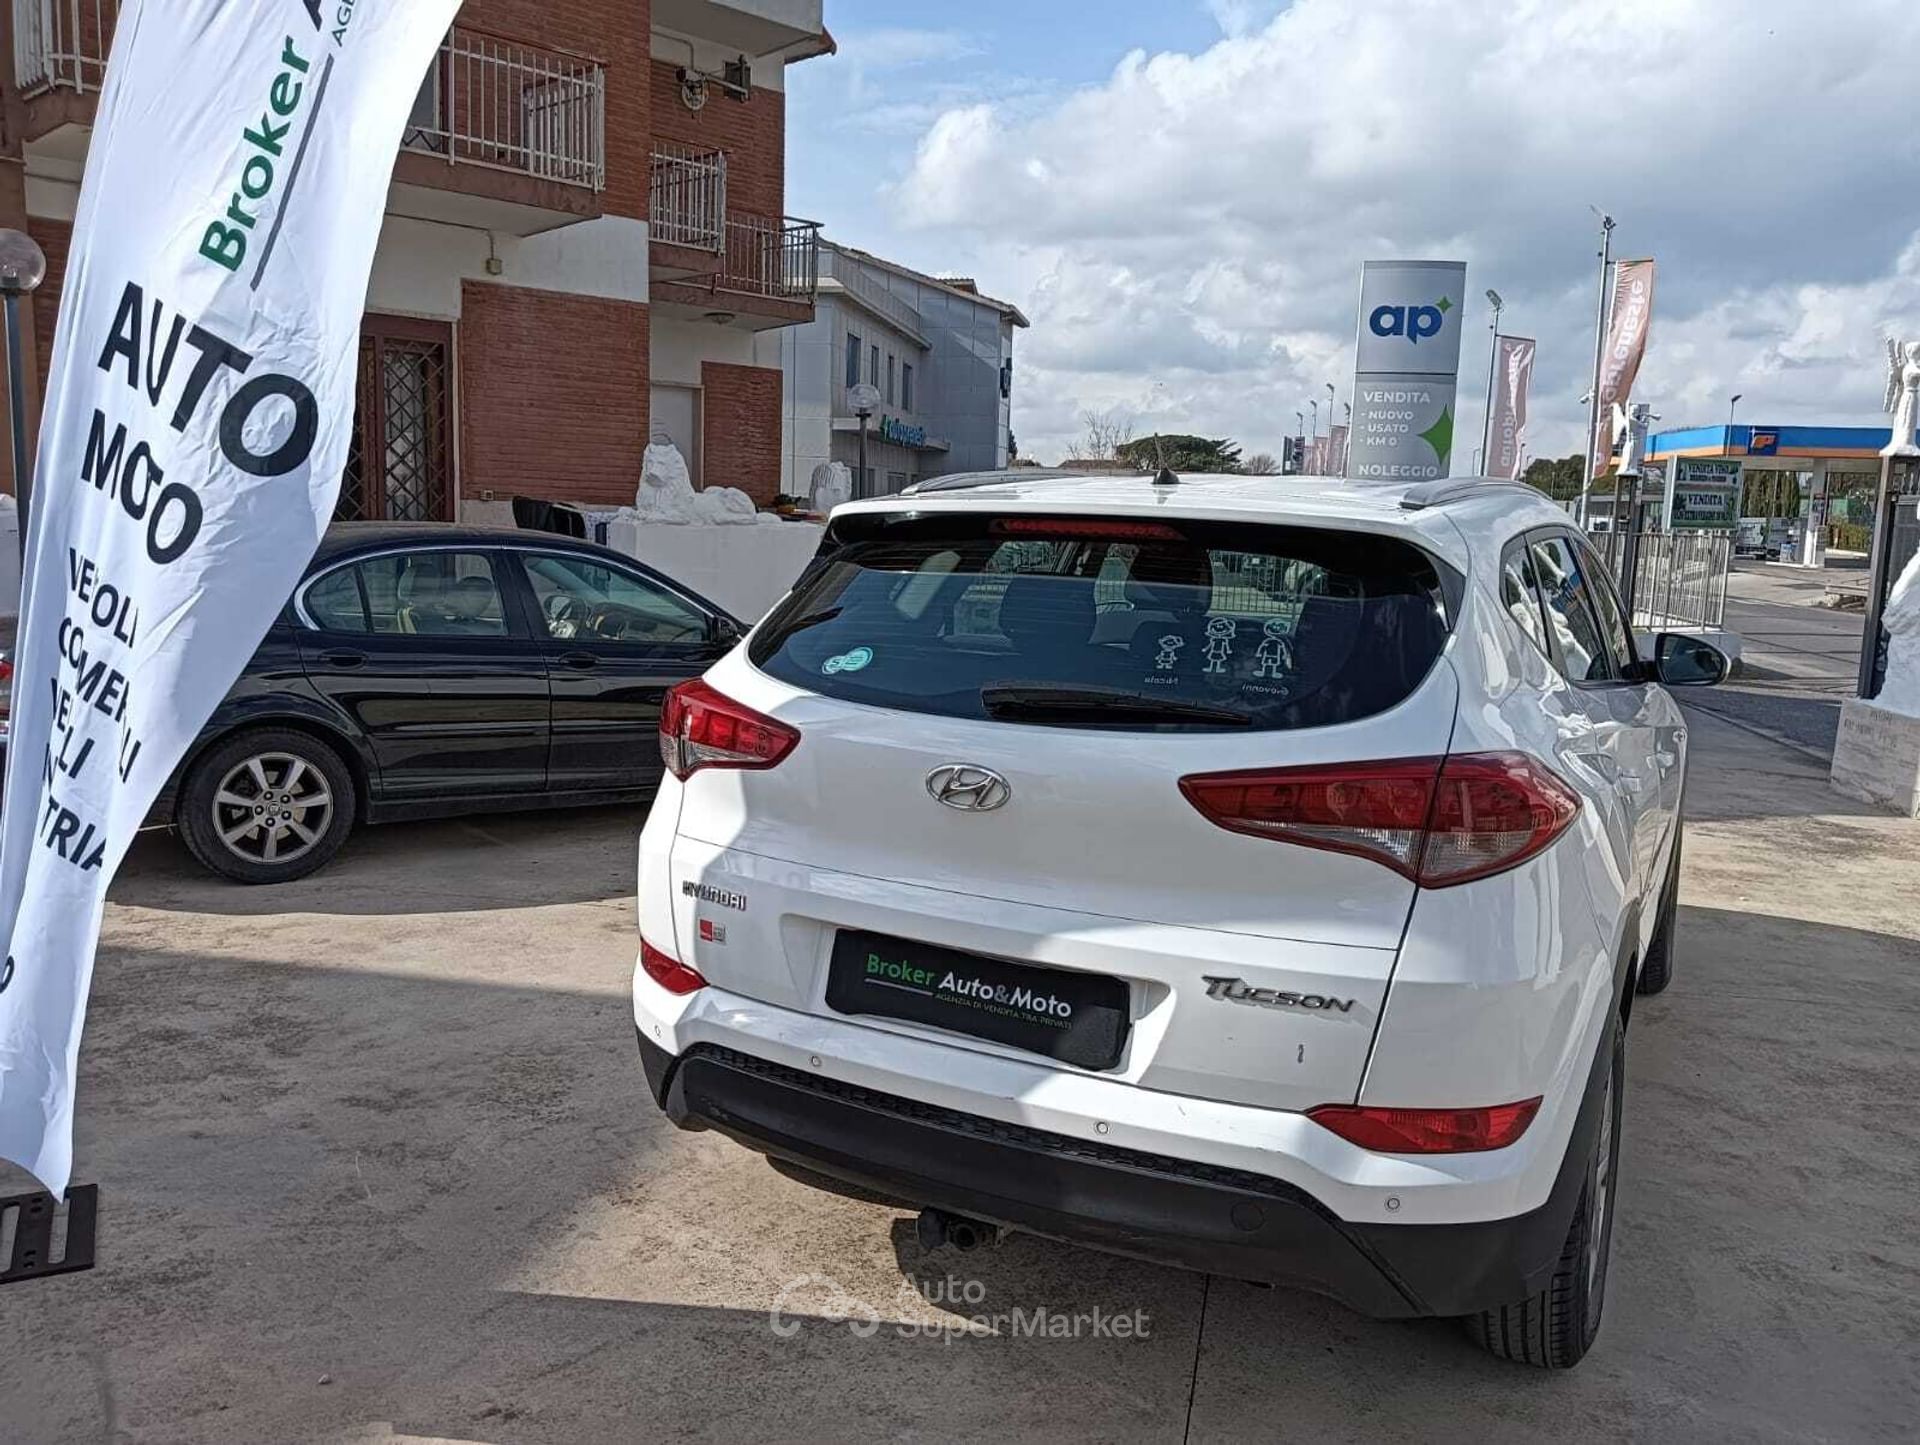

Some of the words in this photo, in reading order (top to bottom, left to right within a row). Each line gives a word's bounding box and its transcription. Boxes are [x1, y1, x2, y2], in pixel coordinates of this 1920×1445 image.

[199, 35, 311, 272] Broker
[97, 280, 319, 477] AUTO
[1363, 390, 1431, 404] VENDITA
[1367, 410, 1414, 421] NUOVO
[1367, 423, 1409, 433] USATO
[1366, 437, 1386, 446] KM
[1358, 463, 1438, 478] NOLEGGIO
[682, 880, 747, 911] HYUNDAI
[866, 953, 936, 986] Broker
[938, 971, 1073, 1018] Auto&Moto
[983, 1002, 1020, 1018] VENDITA
